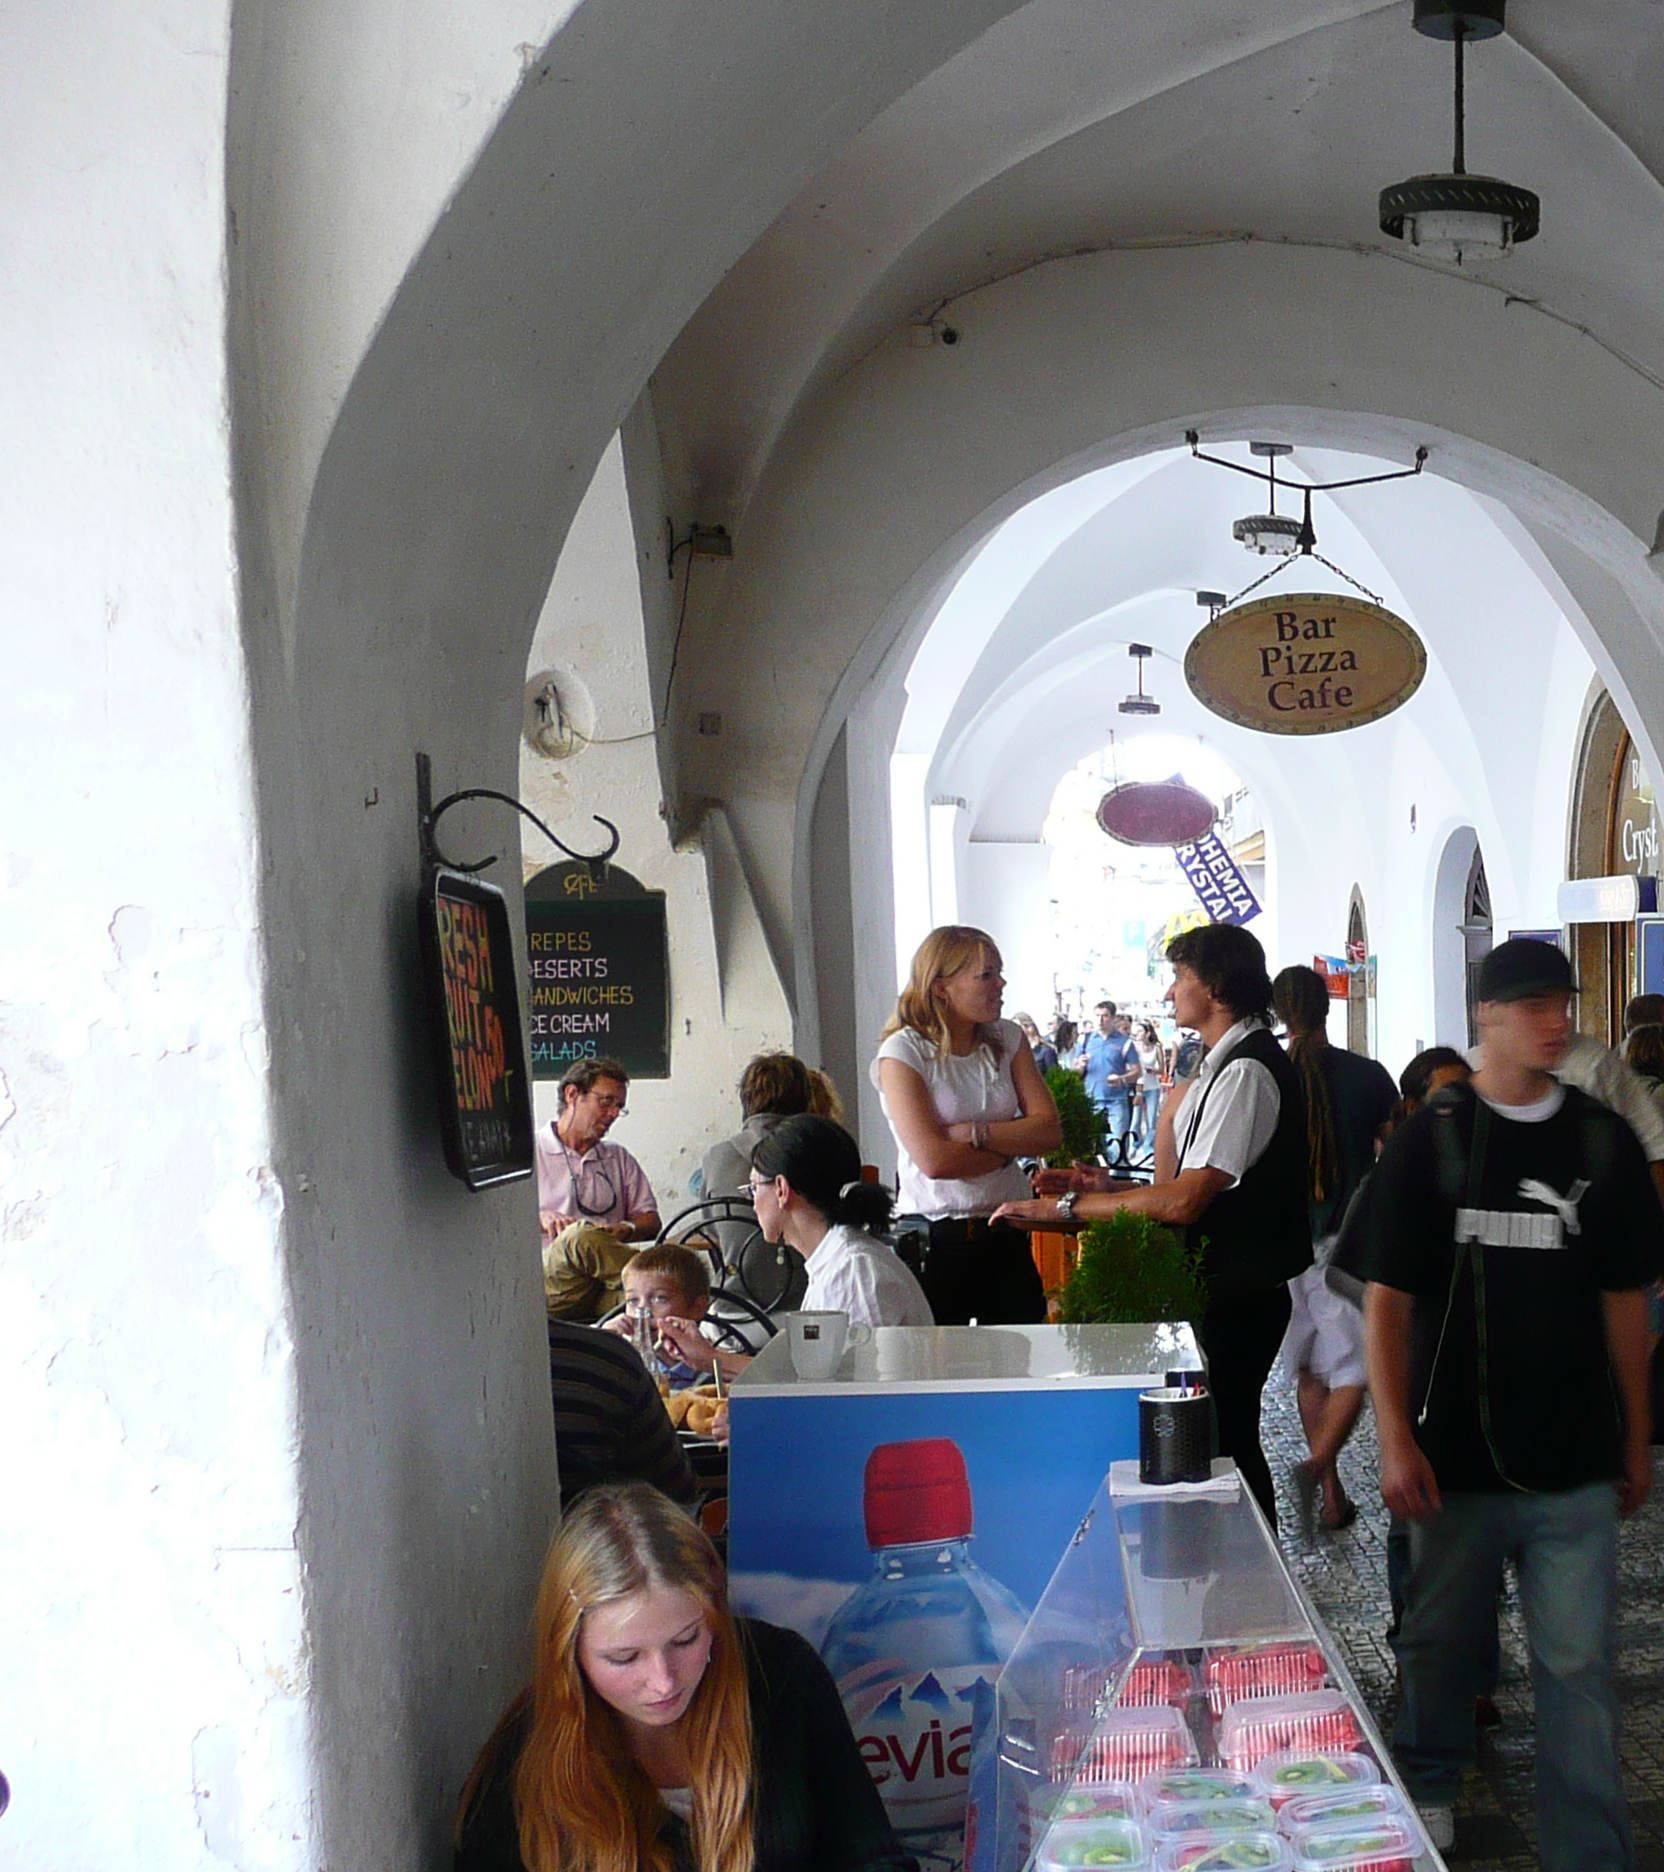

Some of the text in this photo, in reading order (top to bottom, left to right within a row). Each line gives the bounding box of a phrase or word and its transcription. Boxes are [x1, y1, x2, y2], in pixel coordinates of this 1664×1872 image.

[1273, 611, 1337, 642] Bar
[1258, 645, 1359, 678] Pizza
[1267, 677, 1354, 712] Cafe
[530, 931, 592, 951] REPES
[530, 957, 609, 980] ESERTS
[531, 985, 634, 1006] ANDWICHES
[550, 1012, 611, 1034] CREAM
